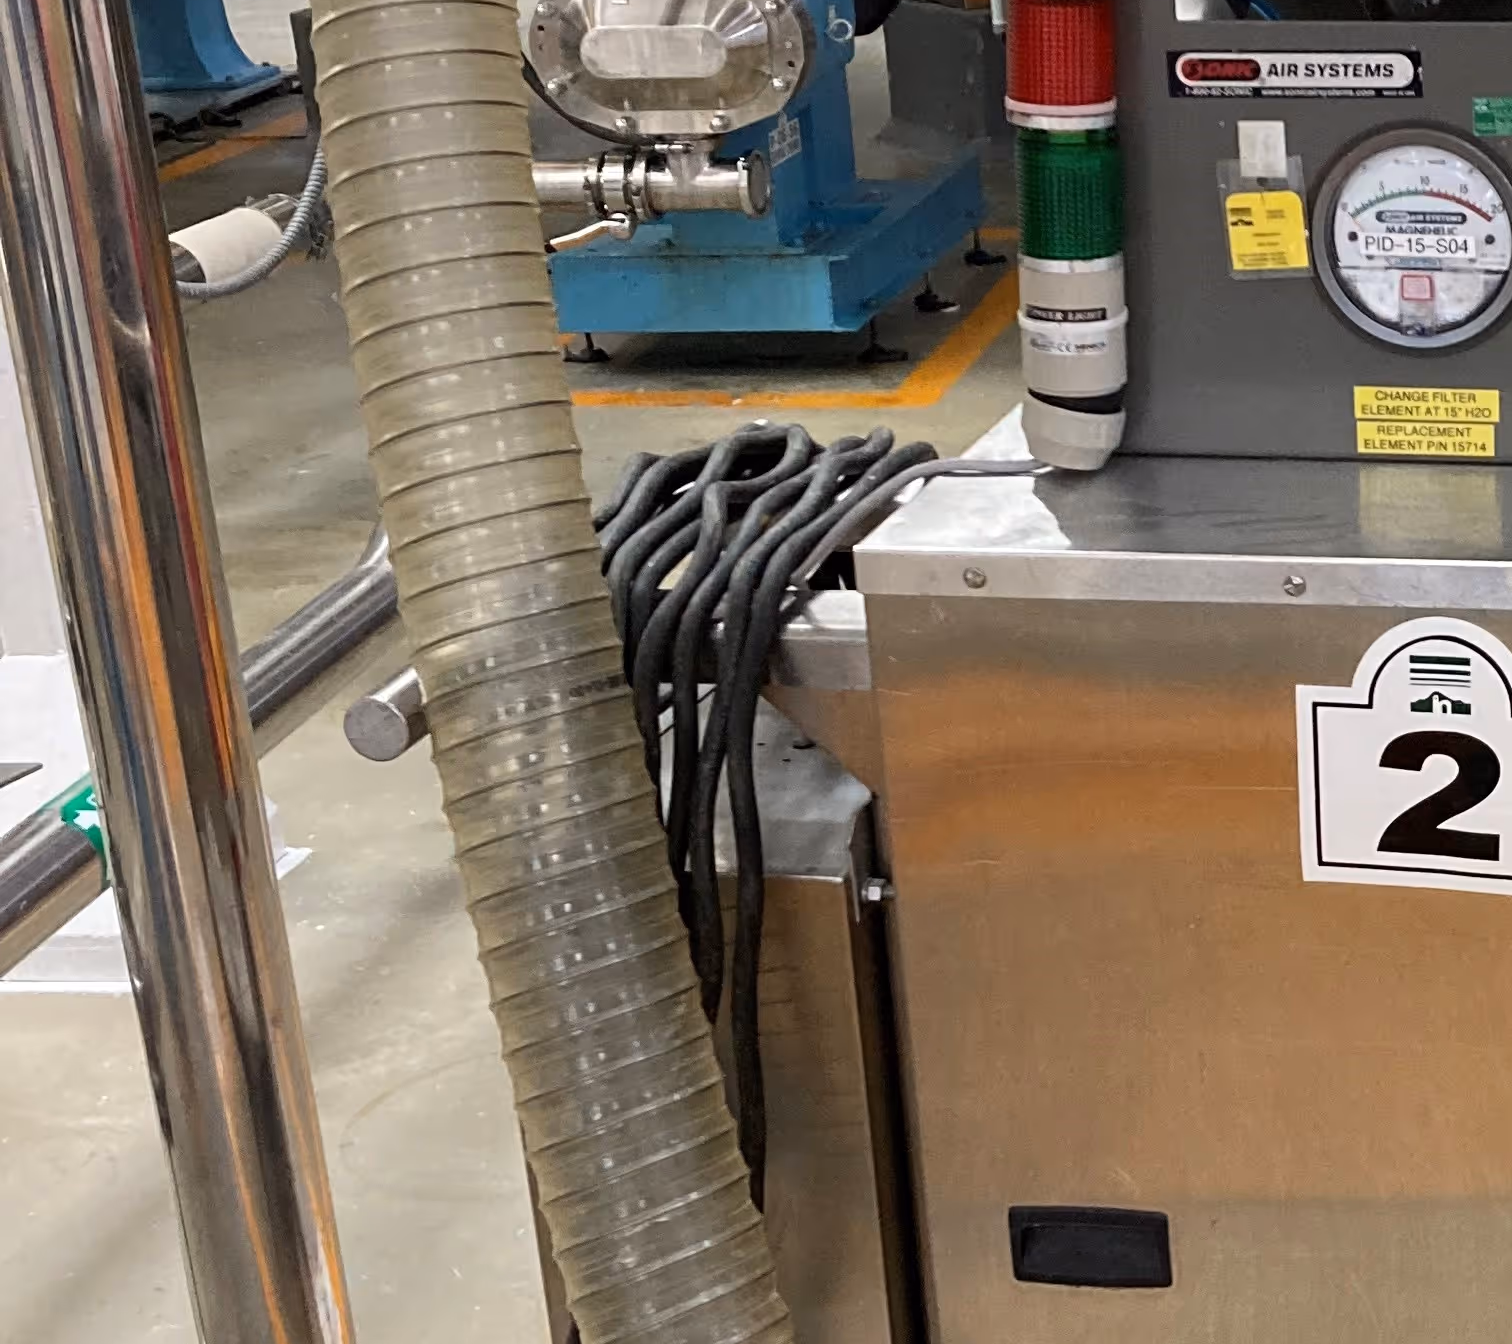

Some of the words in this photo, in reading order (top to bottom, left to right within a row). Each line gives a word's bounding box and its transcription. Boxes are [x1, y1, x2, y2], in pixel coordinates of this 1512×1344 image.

[1267, 63, 1299, 77] AIR
[1304, 63, 1394, 78] SYSTEMS
[1365, 237, 1468, 254] PID-15-S04
[1374, 389, 1430, 402] CHANGE
[1433, 391, 1477, 404] FILTER
[1361, 404, 1422, 416] ELEMENT
[1424, 406, 1440, 416] AT
[1376, 424, 1473, 438] REPLACEMENT
[1364, 438, 1423, 451] ELEMENT
[1452, 441, 1487, 453] 15714
[1377, 730, 1501, 862] 2
